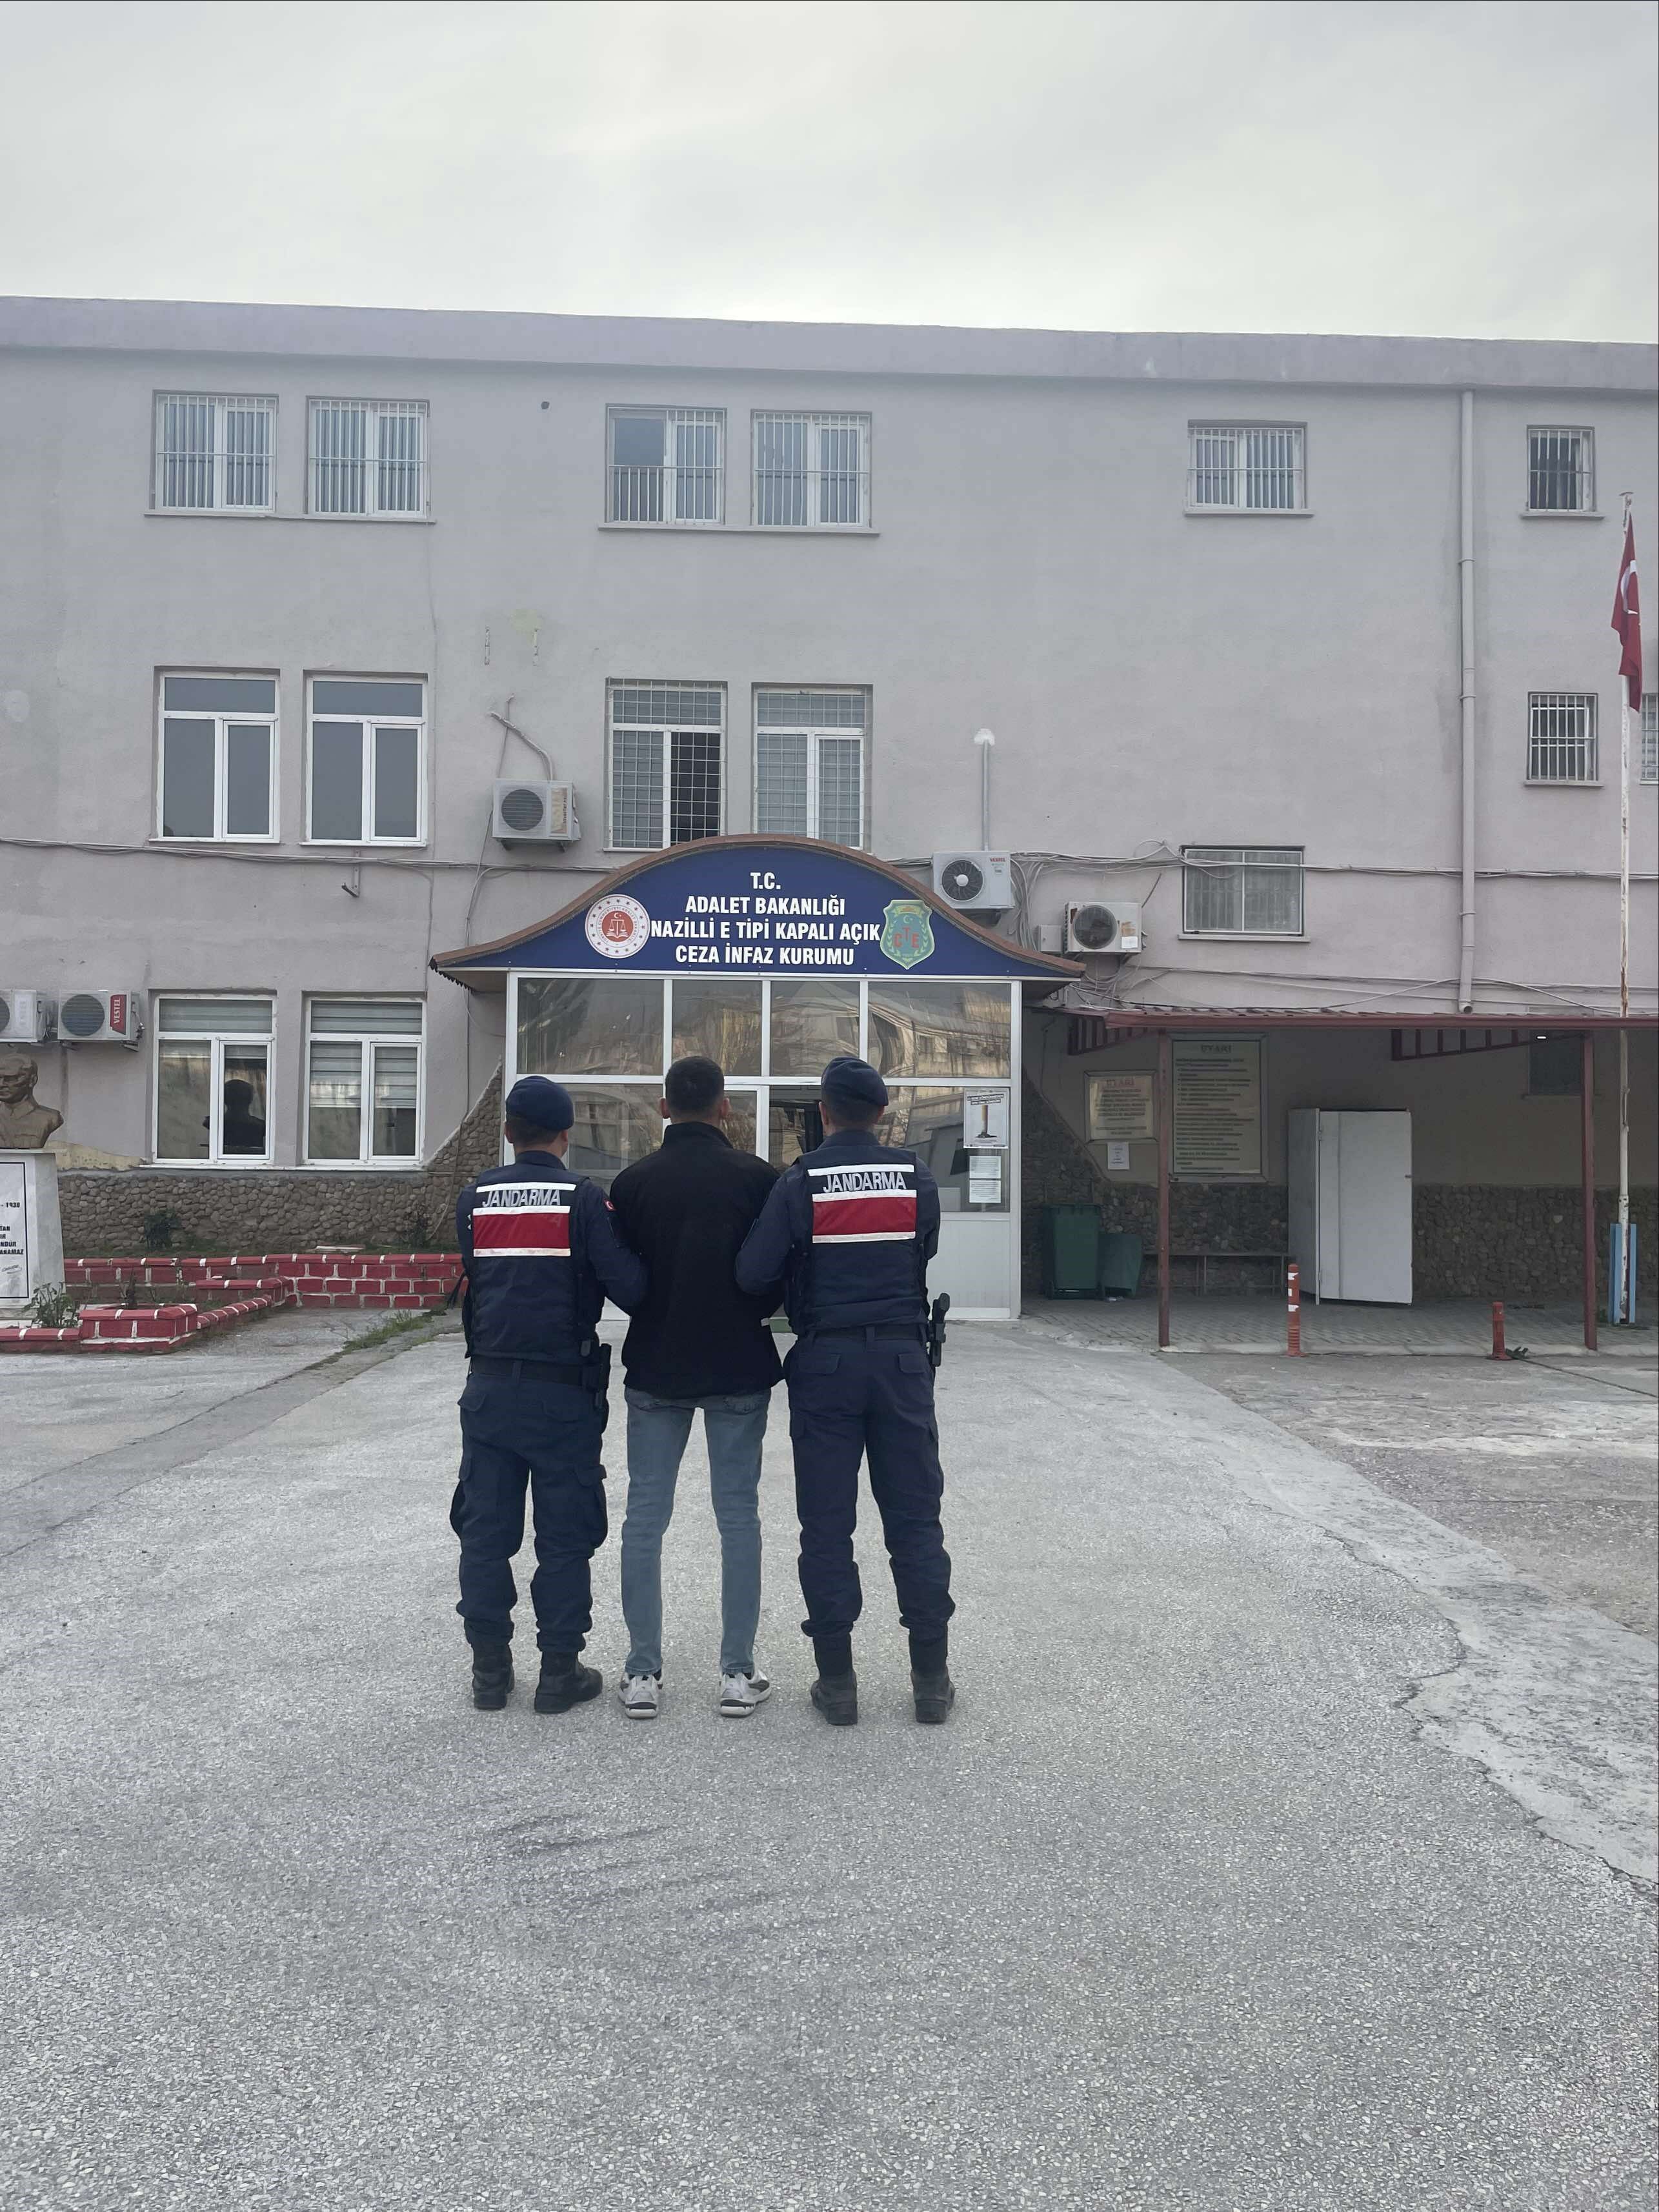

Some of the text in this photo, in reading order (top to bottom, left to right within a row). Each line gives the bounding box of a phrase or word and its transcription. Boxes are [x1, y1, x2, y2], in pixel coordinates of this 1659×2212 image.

[750, 872, 781, 889] T.C.
[685, 894, 845, 915] ADALET BAKANLIĞI
[651, 917, 880, 945] NAZİLLİ E TİPİ KAPALI AÇIK
[676, 943, 854, 965] CEZA İNFAZ KURUMU
[823, 1171, 907, 1193] JANDARMA
[482, 1189, 560, 1207] JANDARMA
